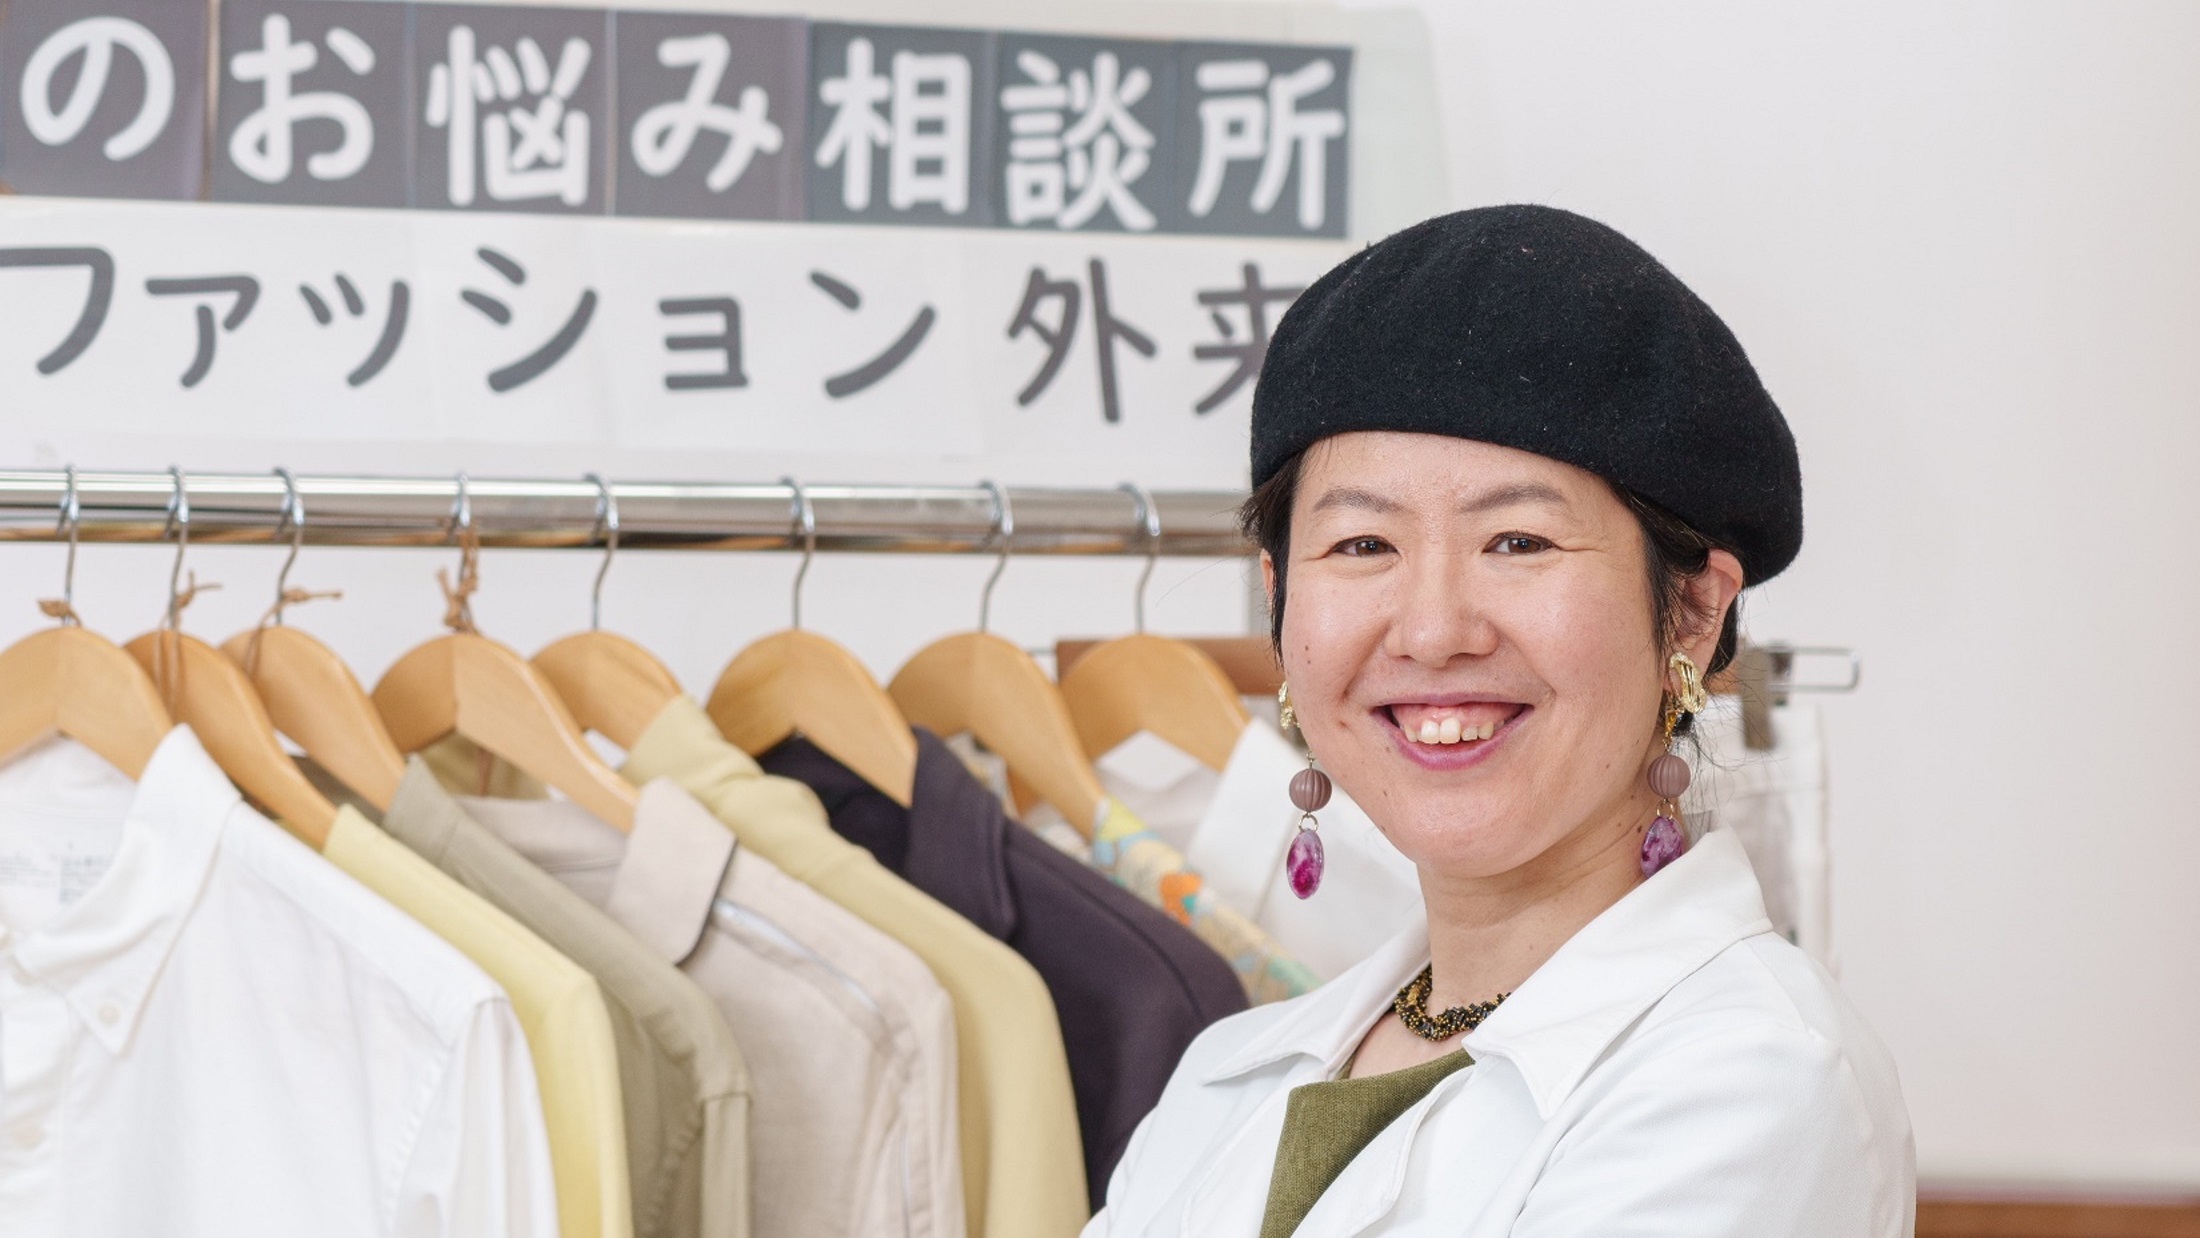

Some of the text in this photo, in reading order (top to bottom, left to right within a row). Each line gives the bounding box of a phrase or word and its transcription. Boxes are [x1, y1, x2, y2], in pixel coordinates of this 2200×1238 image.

[20, 13, 1346, 230] のお悩み相談所
